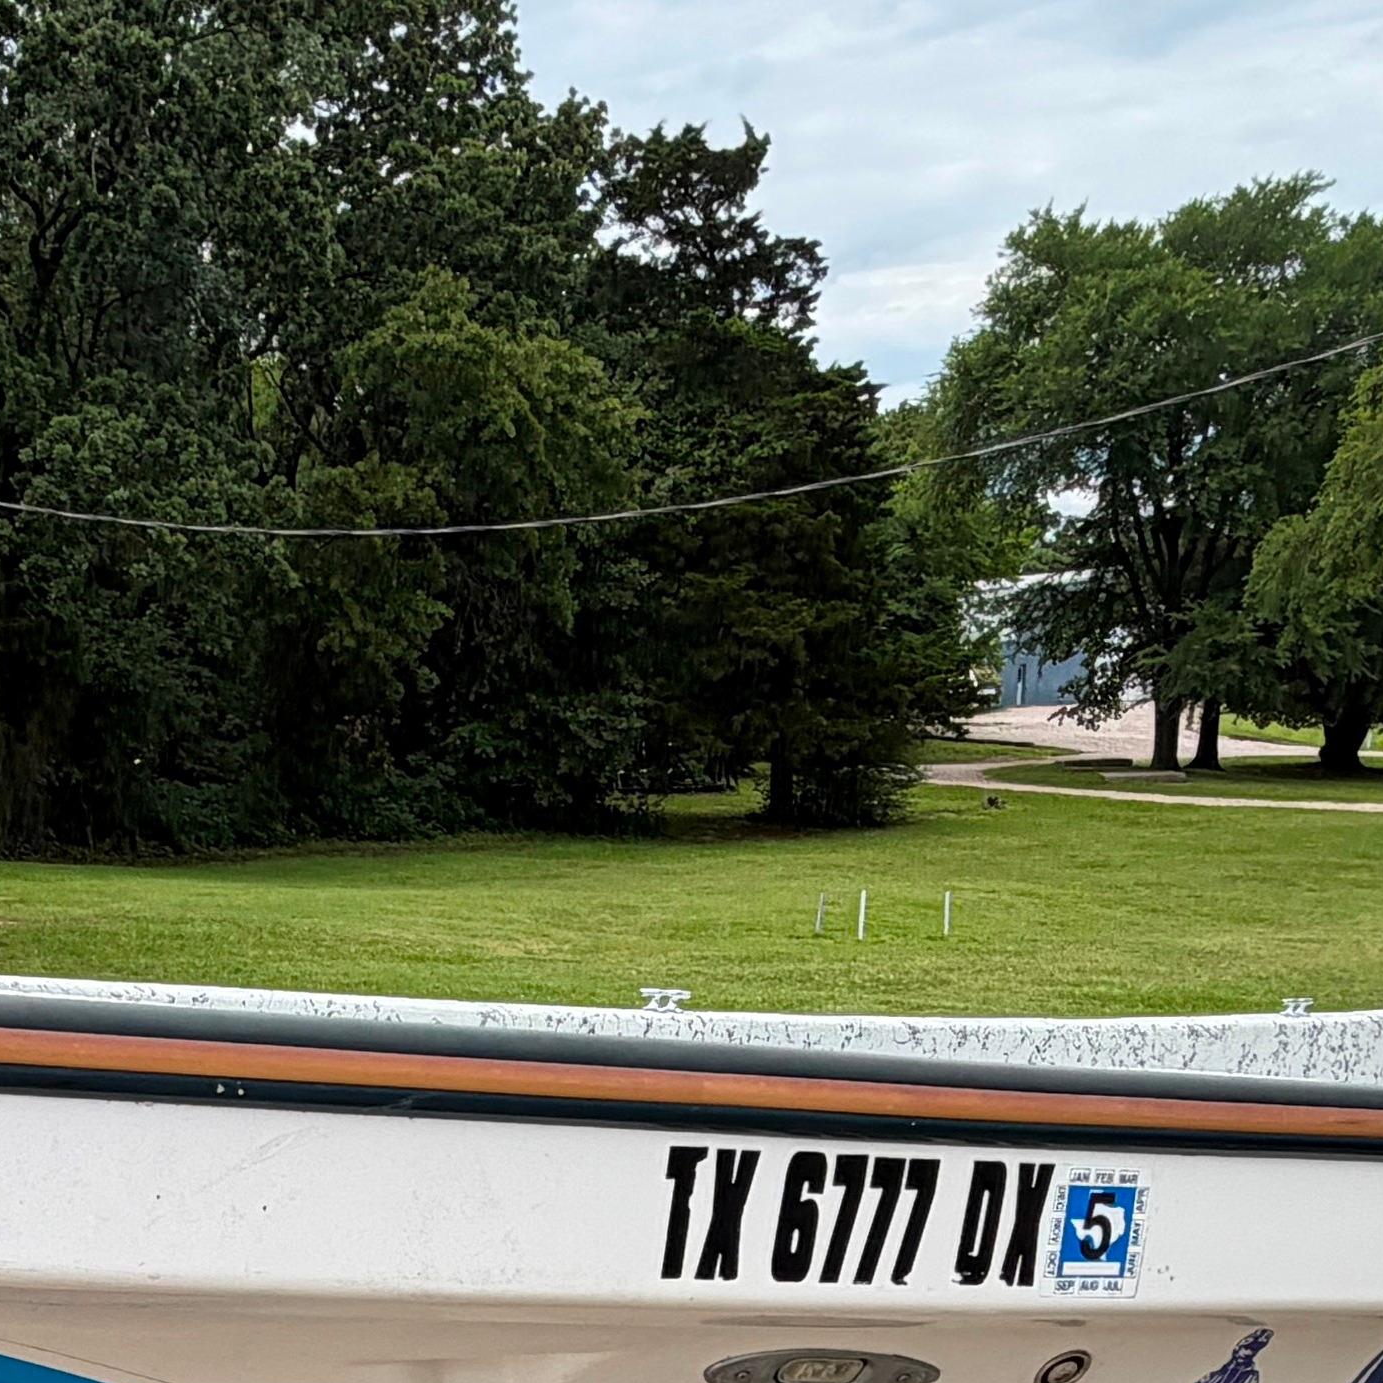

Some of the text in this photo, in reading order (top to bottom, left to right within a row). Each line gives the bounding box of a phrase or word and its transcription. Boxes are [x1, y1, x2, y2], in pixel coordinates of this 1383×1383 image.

[1072, 1172, 1137, 1184] JAN FEB MAR
[1056, 1186, 1066, 1210] DEC
[1136, 1188, 1146, 1211] APR
[661, 1146, 1056, 1287] TX 6777 DX
[1080, 1192, 1116, 1261] 5
[1051, 1218, 1062, 1243] NOV
[1131, 1222, 1141, 1246] MAY
[1047, 1254, 1057, 1275] OCT
[1127, 1254, 1137, 1275] JUN
[1056, 1280, 1121, 1291] SEP AUG JUL
